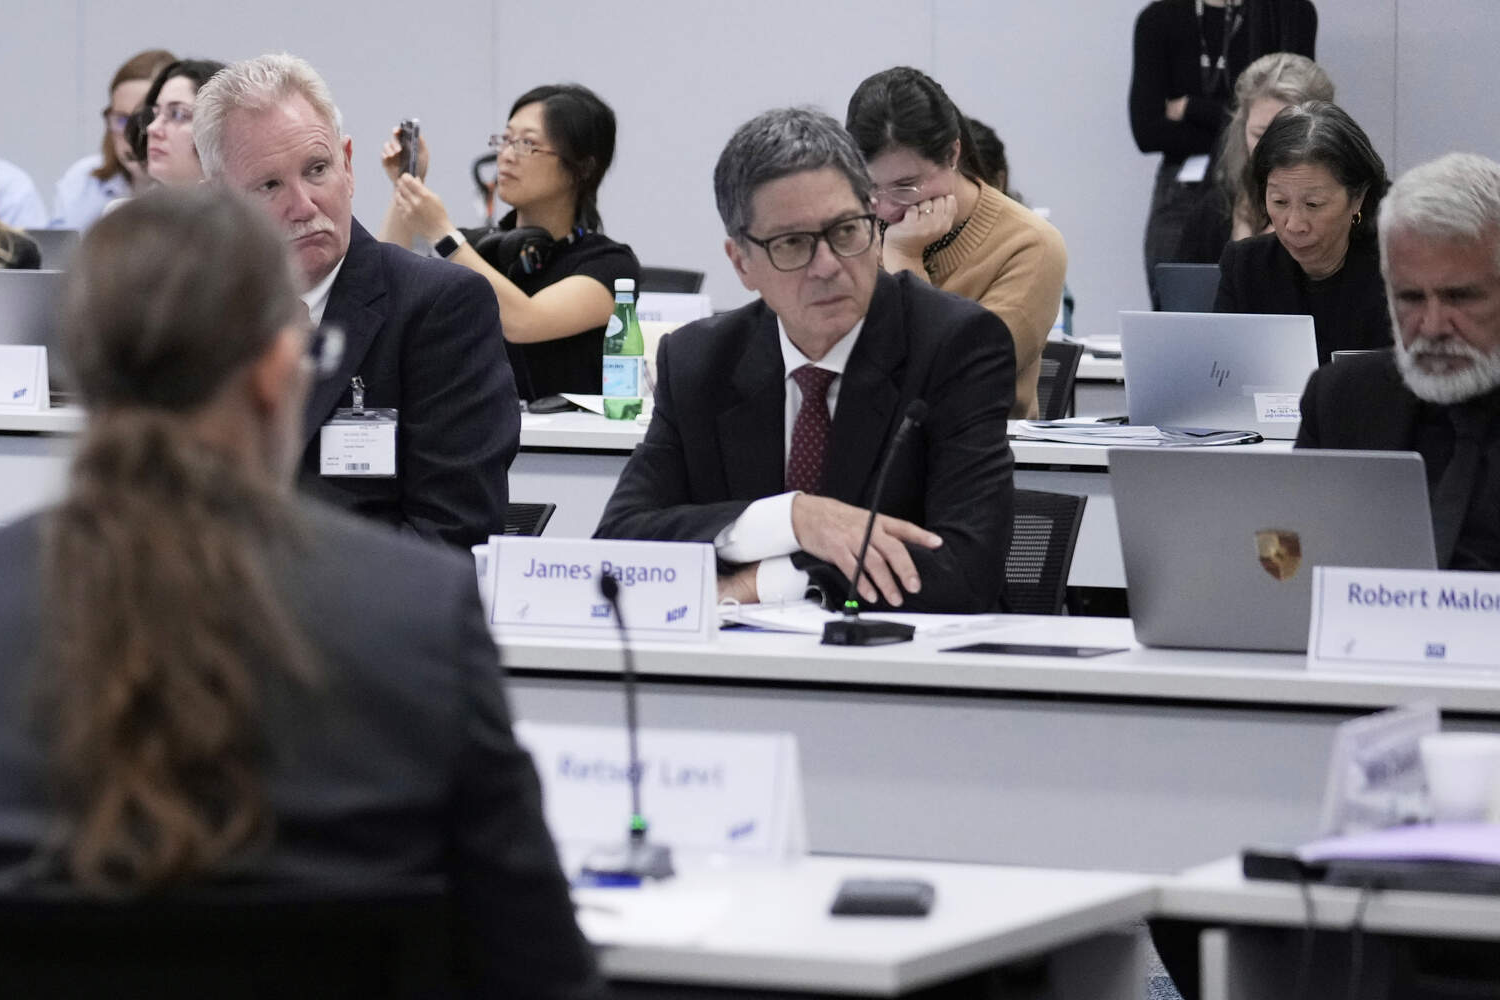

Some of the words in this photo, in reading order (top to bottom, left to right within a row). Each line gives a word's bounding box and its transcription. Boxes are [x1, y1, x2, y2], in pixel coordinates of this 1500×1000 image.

[523, 558, 592, 580] James
[600, 560, 677, 587] Pagano
[1348, 582, 1429, 608] Robert
